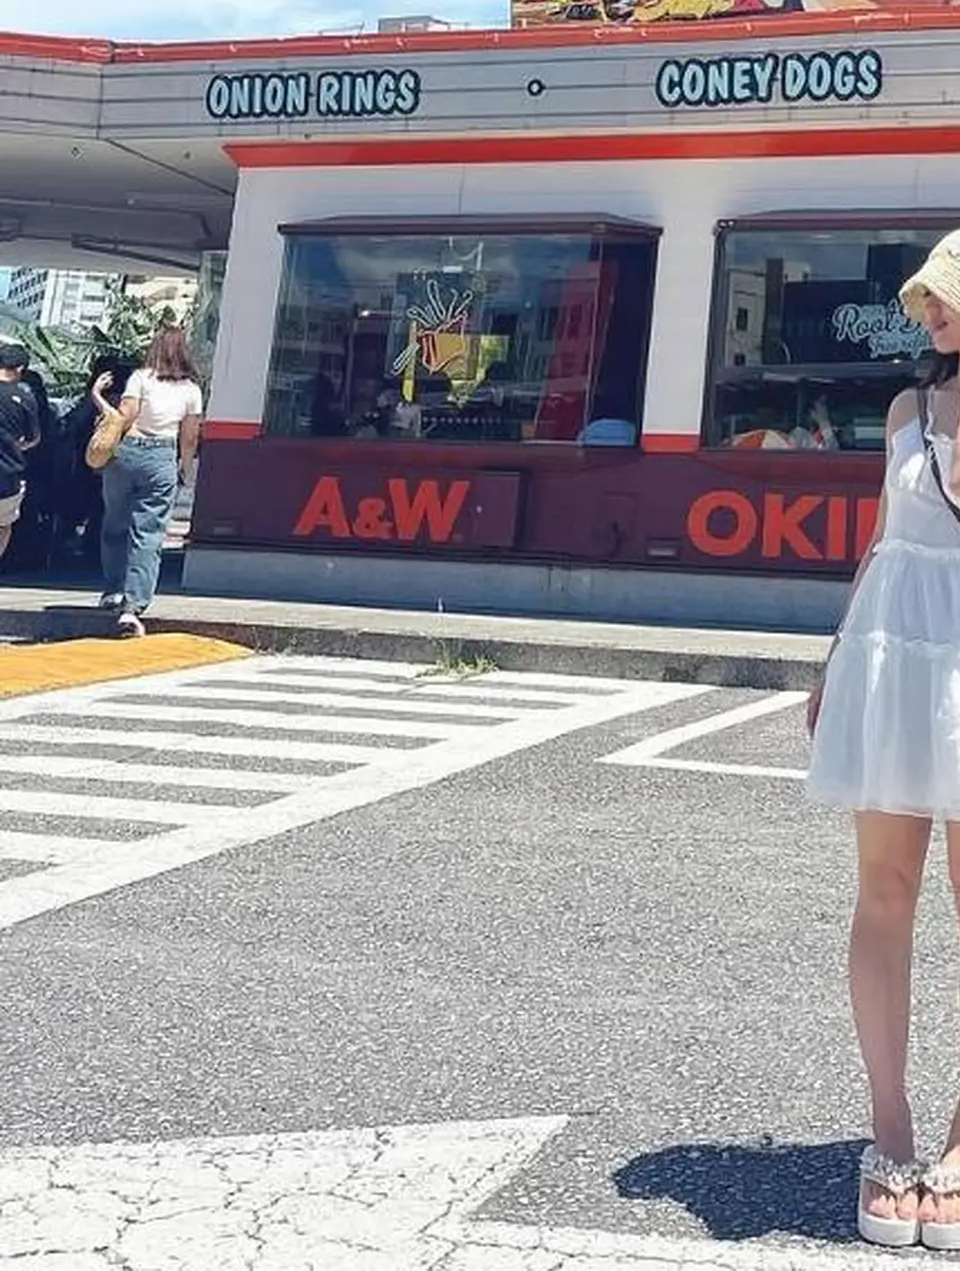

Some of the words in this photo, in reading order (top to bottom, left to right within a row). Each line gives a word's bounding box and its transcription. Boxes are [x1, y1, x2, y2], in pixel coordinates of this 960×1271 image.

[207, 73, 310, 119] ONION
[317, 69, 420, 117] RINGS
[657, 54, 779, 106] CONEY
[782, 49, 882, 101] DOGS
[293, 475, 470, 544] A&W
